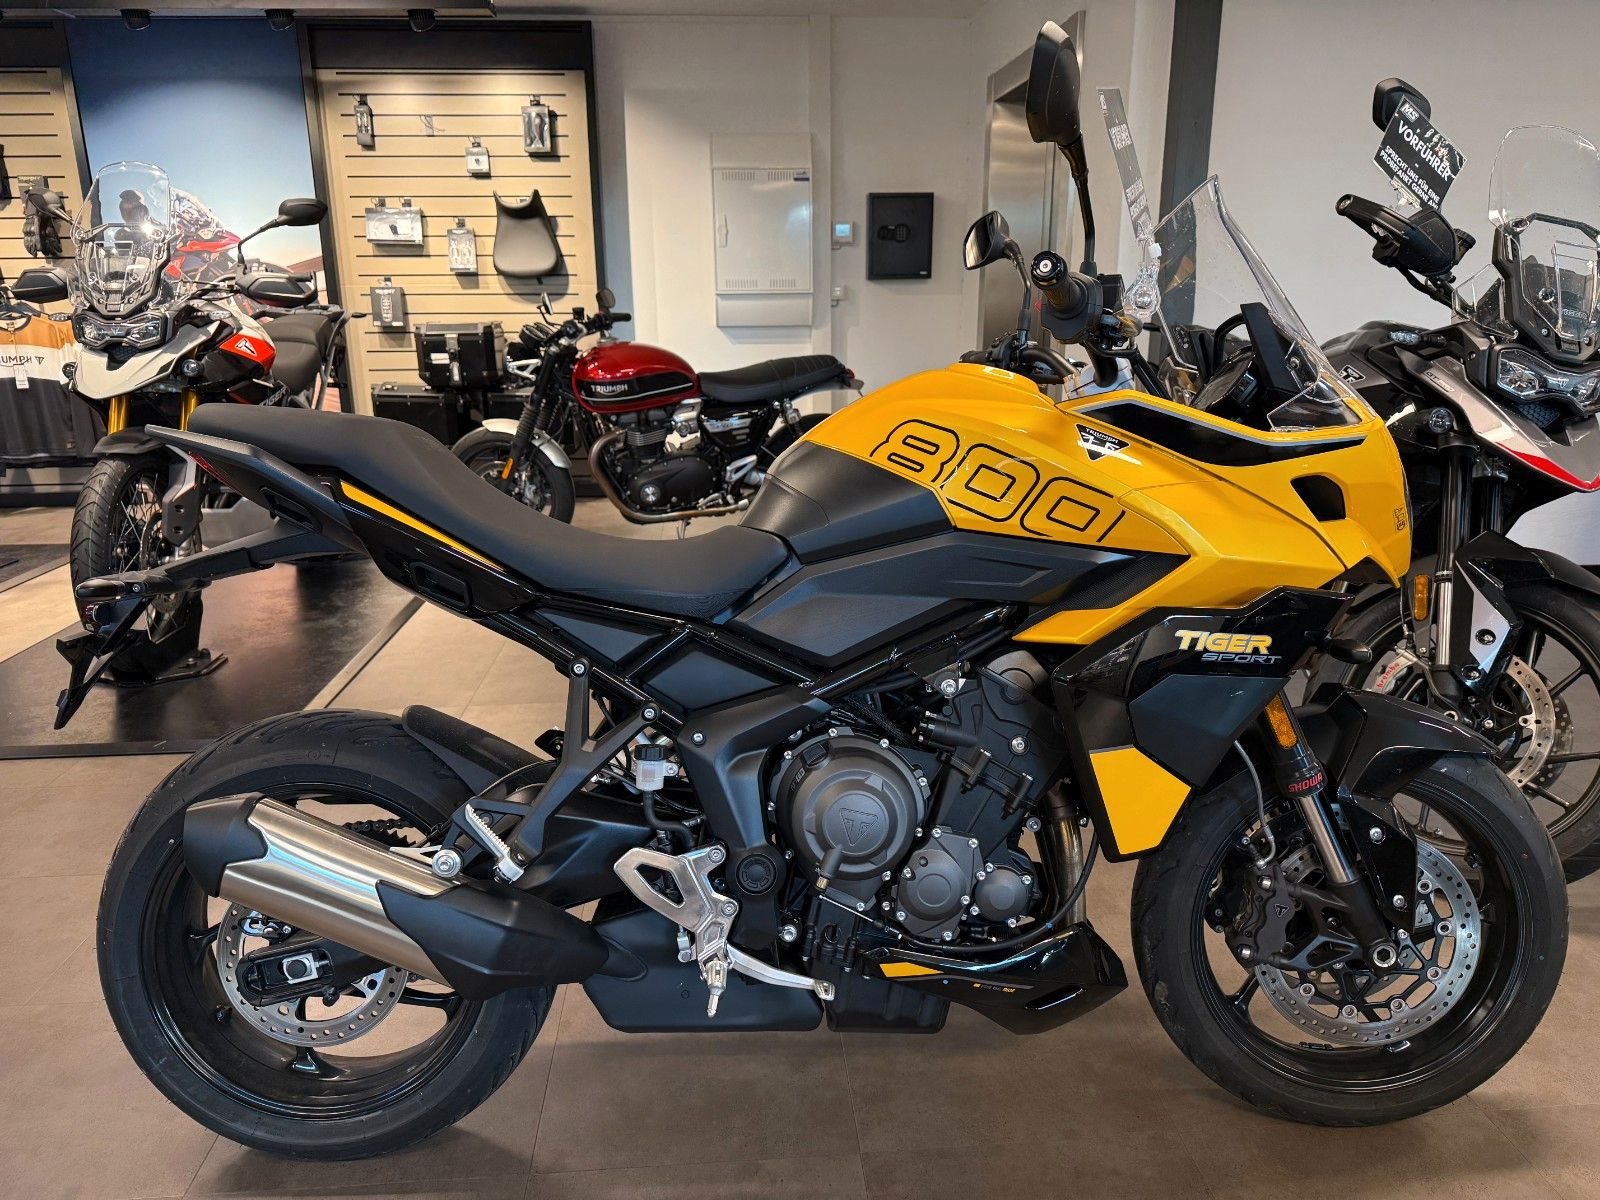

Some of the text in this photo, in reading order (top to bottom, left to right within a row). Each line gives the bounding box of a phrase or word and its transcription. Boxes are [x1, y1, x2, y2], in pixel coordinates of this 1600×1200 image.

[1401, 103, 1419, 121] MS
[1398, 120, 1451, 181] VORFÜHRER
[1380, 149, 1413, 186] PROBEFAHRT
[1411, 181, 1430, 203] GERNE
[1384, 145, 1440, 203] SPRECHT UNS FÜR EINE
[0, 355, 33, 364] UMPH
[590, 384, 628, 395] TRIUMPH
[1086, 427, 1119, 444] TRIUMPH
[869, 418, 1127, 543] 800
[1174, 629, 1273, 655] TIGER
[1201, 652, 1282, 664] SPORT
[1288, 772, 1323, 792] SHOWA
